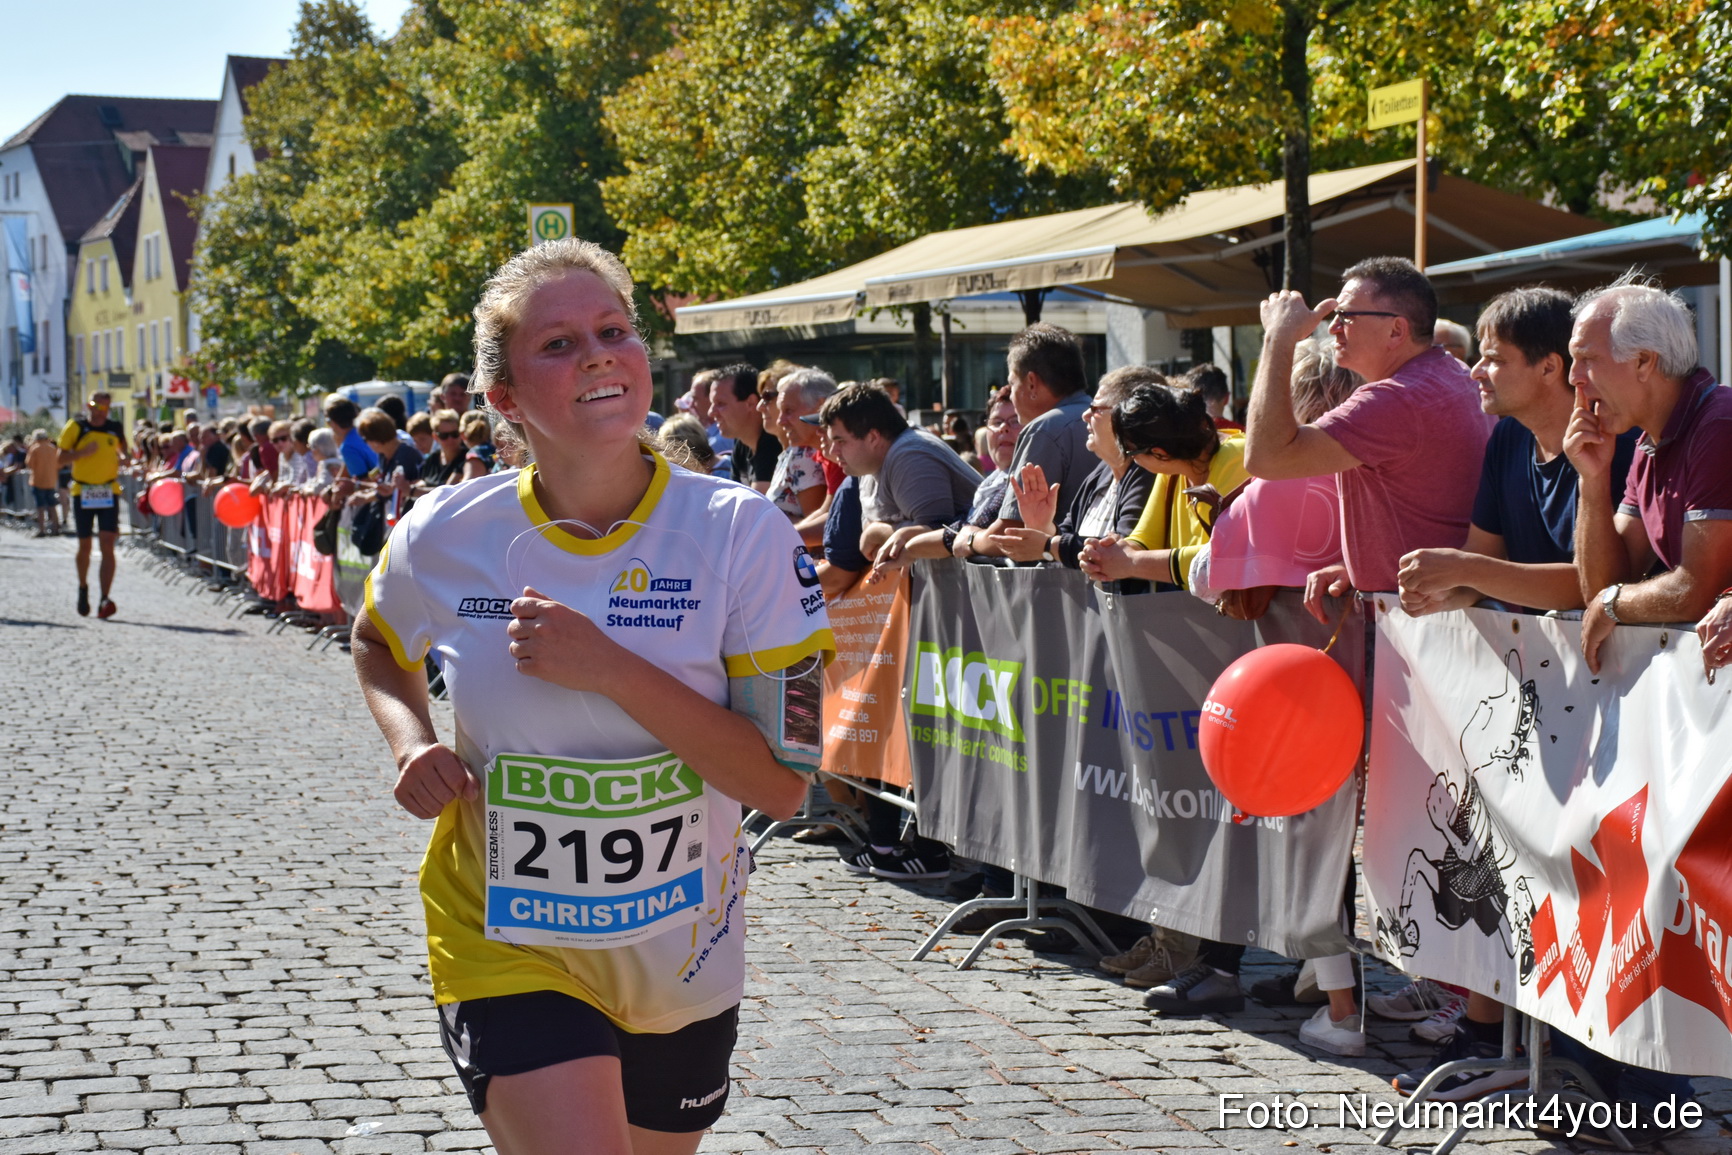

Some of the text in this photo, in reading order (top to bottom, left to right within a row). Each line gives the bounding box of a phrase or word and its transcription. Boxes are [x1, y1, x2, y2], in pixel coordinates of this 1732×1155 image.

[1379, 96, 1419, 115] Toiletten
[544, 218, 559, 235] H
[612, 567, 689, 593] 20 JAHRE
[608, 596, 701, 610] Neumarkter
[606, 614, 685, 631] Stadtlauf
[1208, 715, 1235, 730] energie
[859, 729, 878, 742] 897
[503, 760, 688, 809] BOCK
[691, 813, 700, 824] D
[513, 815, 684, 884] 2197
[509, 884, 687, 927] CHRISTINA
[682, 946, 712, 984] 14./15.
[1618, 971, 1635, 993] Sicher
